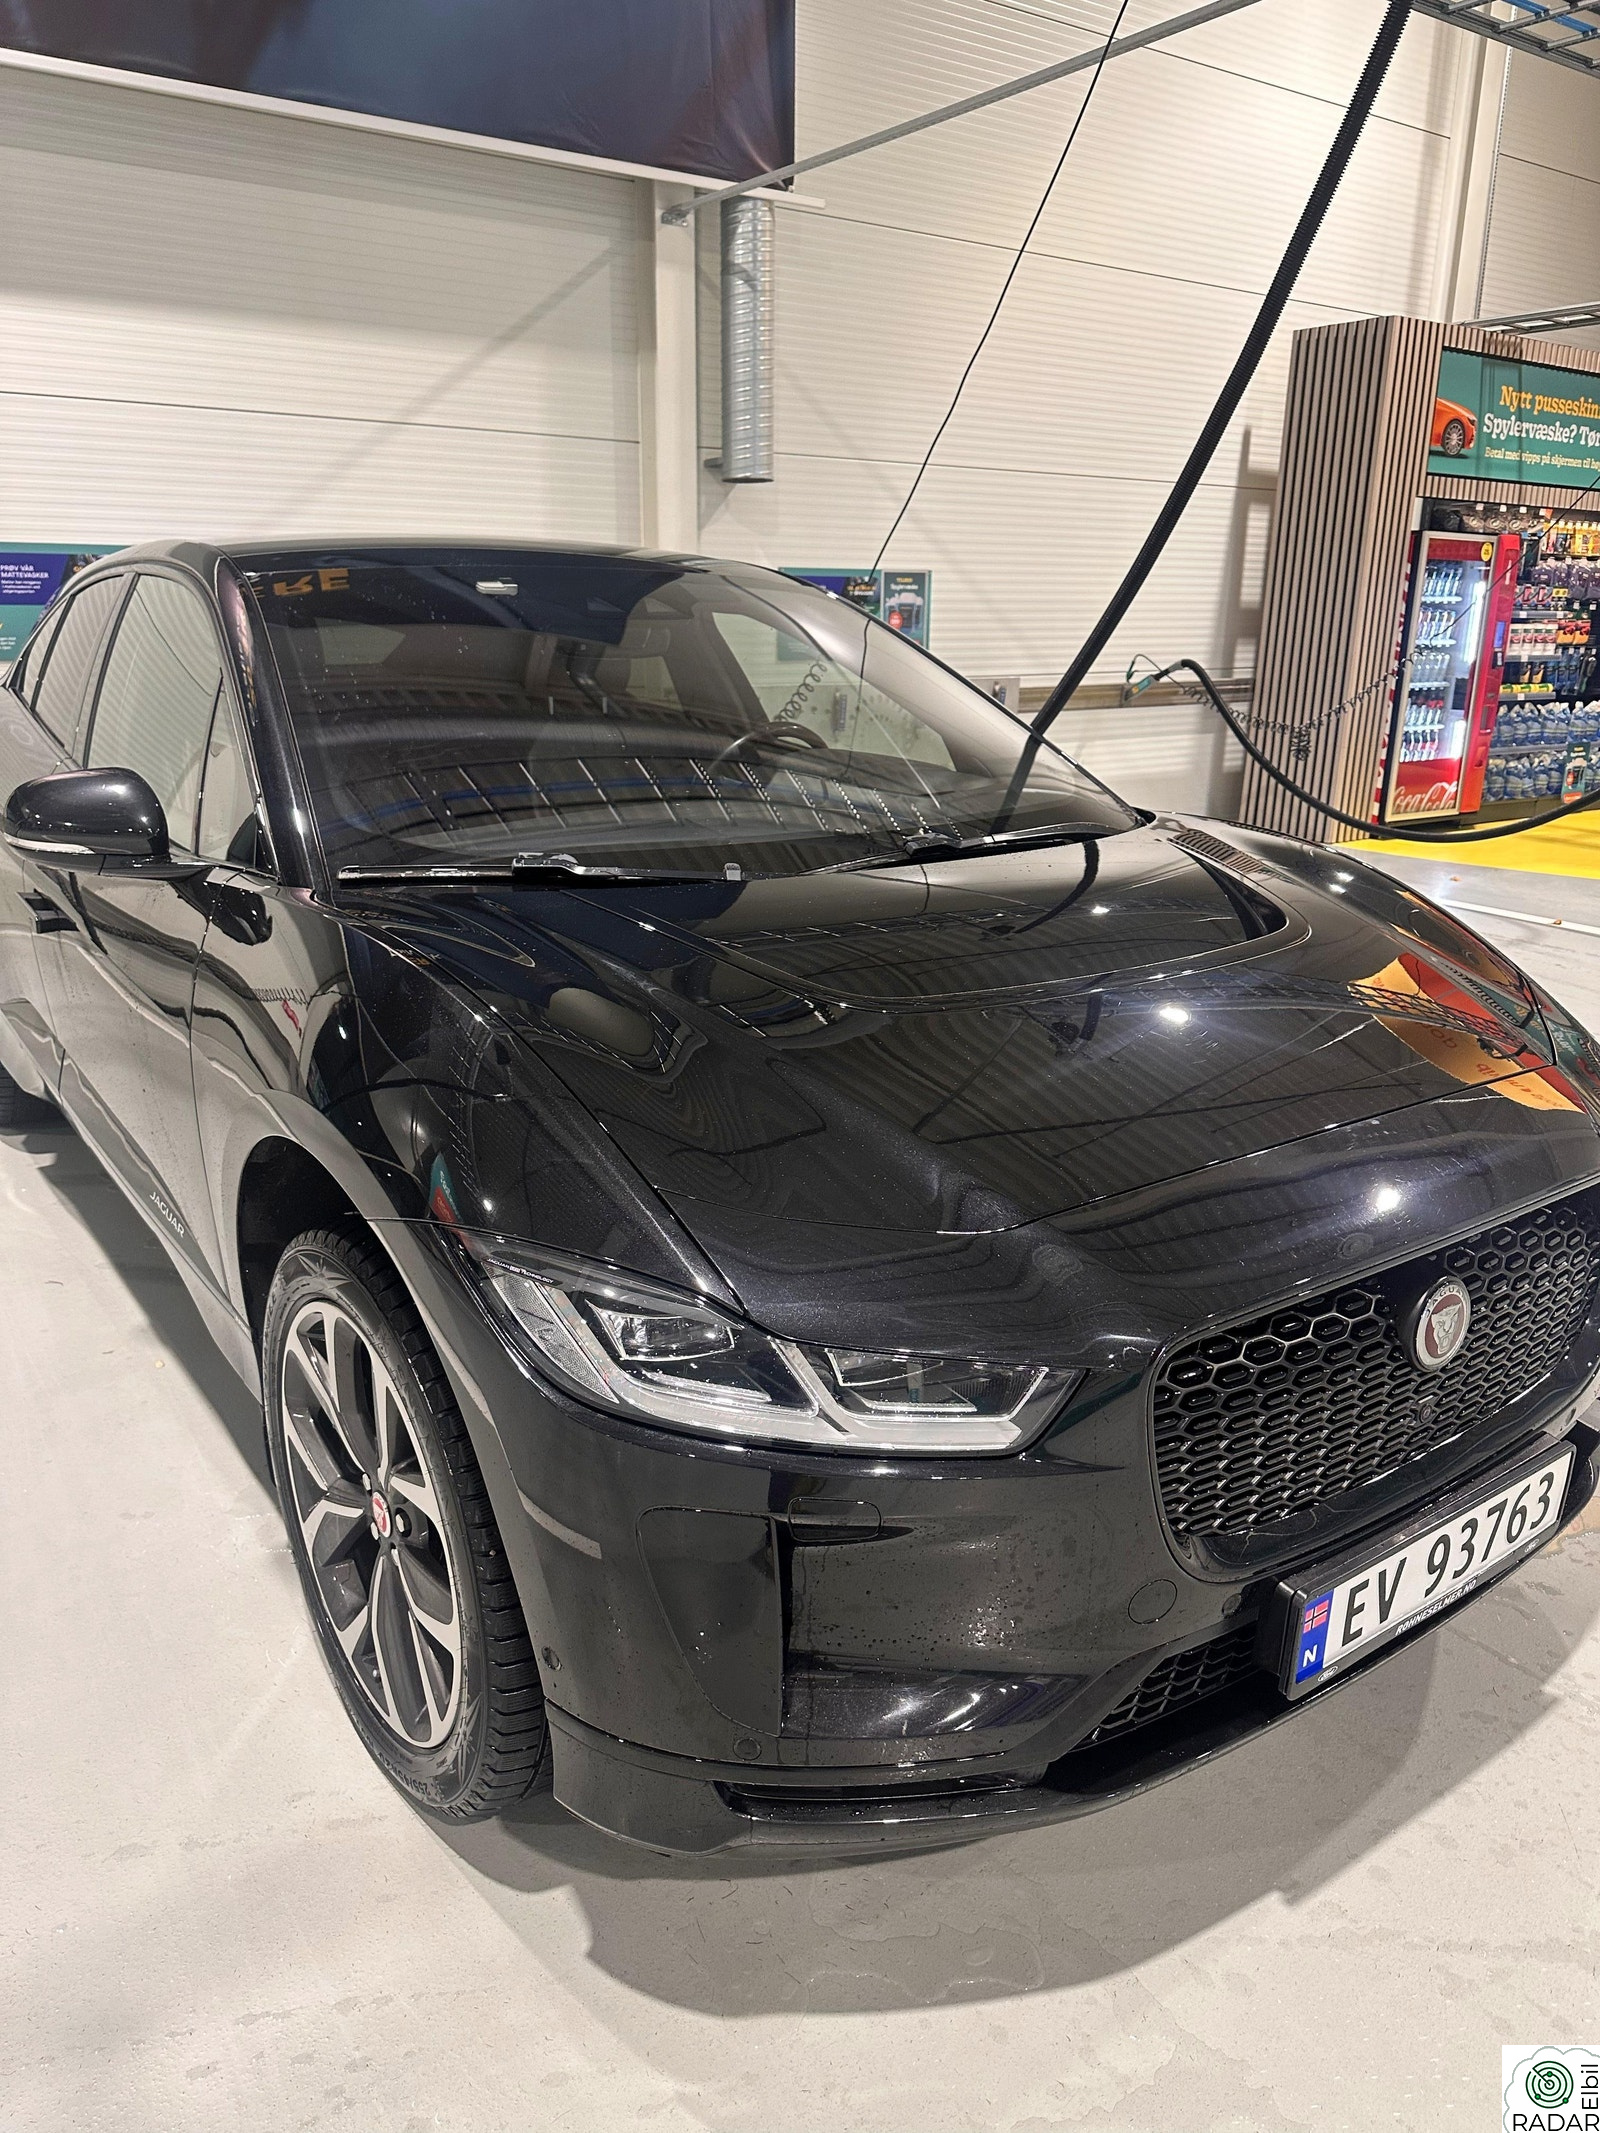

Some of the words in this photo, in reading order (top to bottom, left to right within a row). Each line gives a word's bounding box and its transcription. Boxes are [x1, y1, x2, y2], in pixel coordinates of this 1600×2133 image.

[1500, 385, 1531, 412] Nytt
[1533, 395, 1600, 419] pusseskin
[1483, 413, 1577, 443] Spylervæske?
[1484, 447, 1504, 459] Betal
[1505, 449, 1521, 461] med
[1521, 450, 1541, 465] vipps
[1541, 451, 1551, 466] på
[1551, 454, 1581, 468] skjermen
[149, 1191, 185, 1238] JAGUAR
[487, 1258, 510, 1269] JAGUAR
[1341, 1557, 1407, 1647] EV
[1424, 1472, 1555, 1598] 93763
[1302, 1643, 1318, 1668] N
